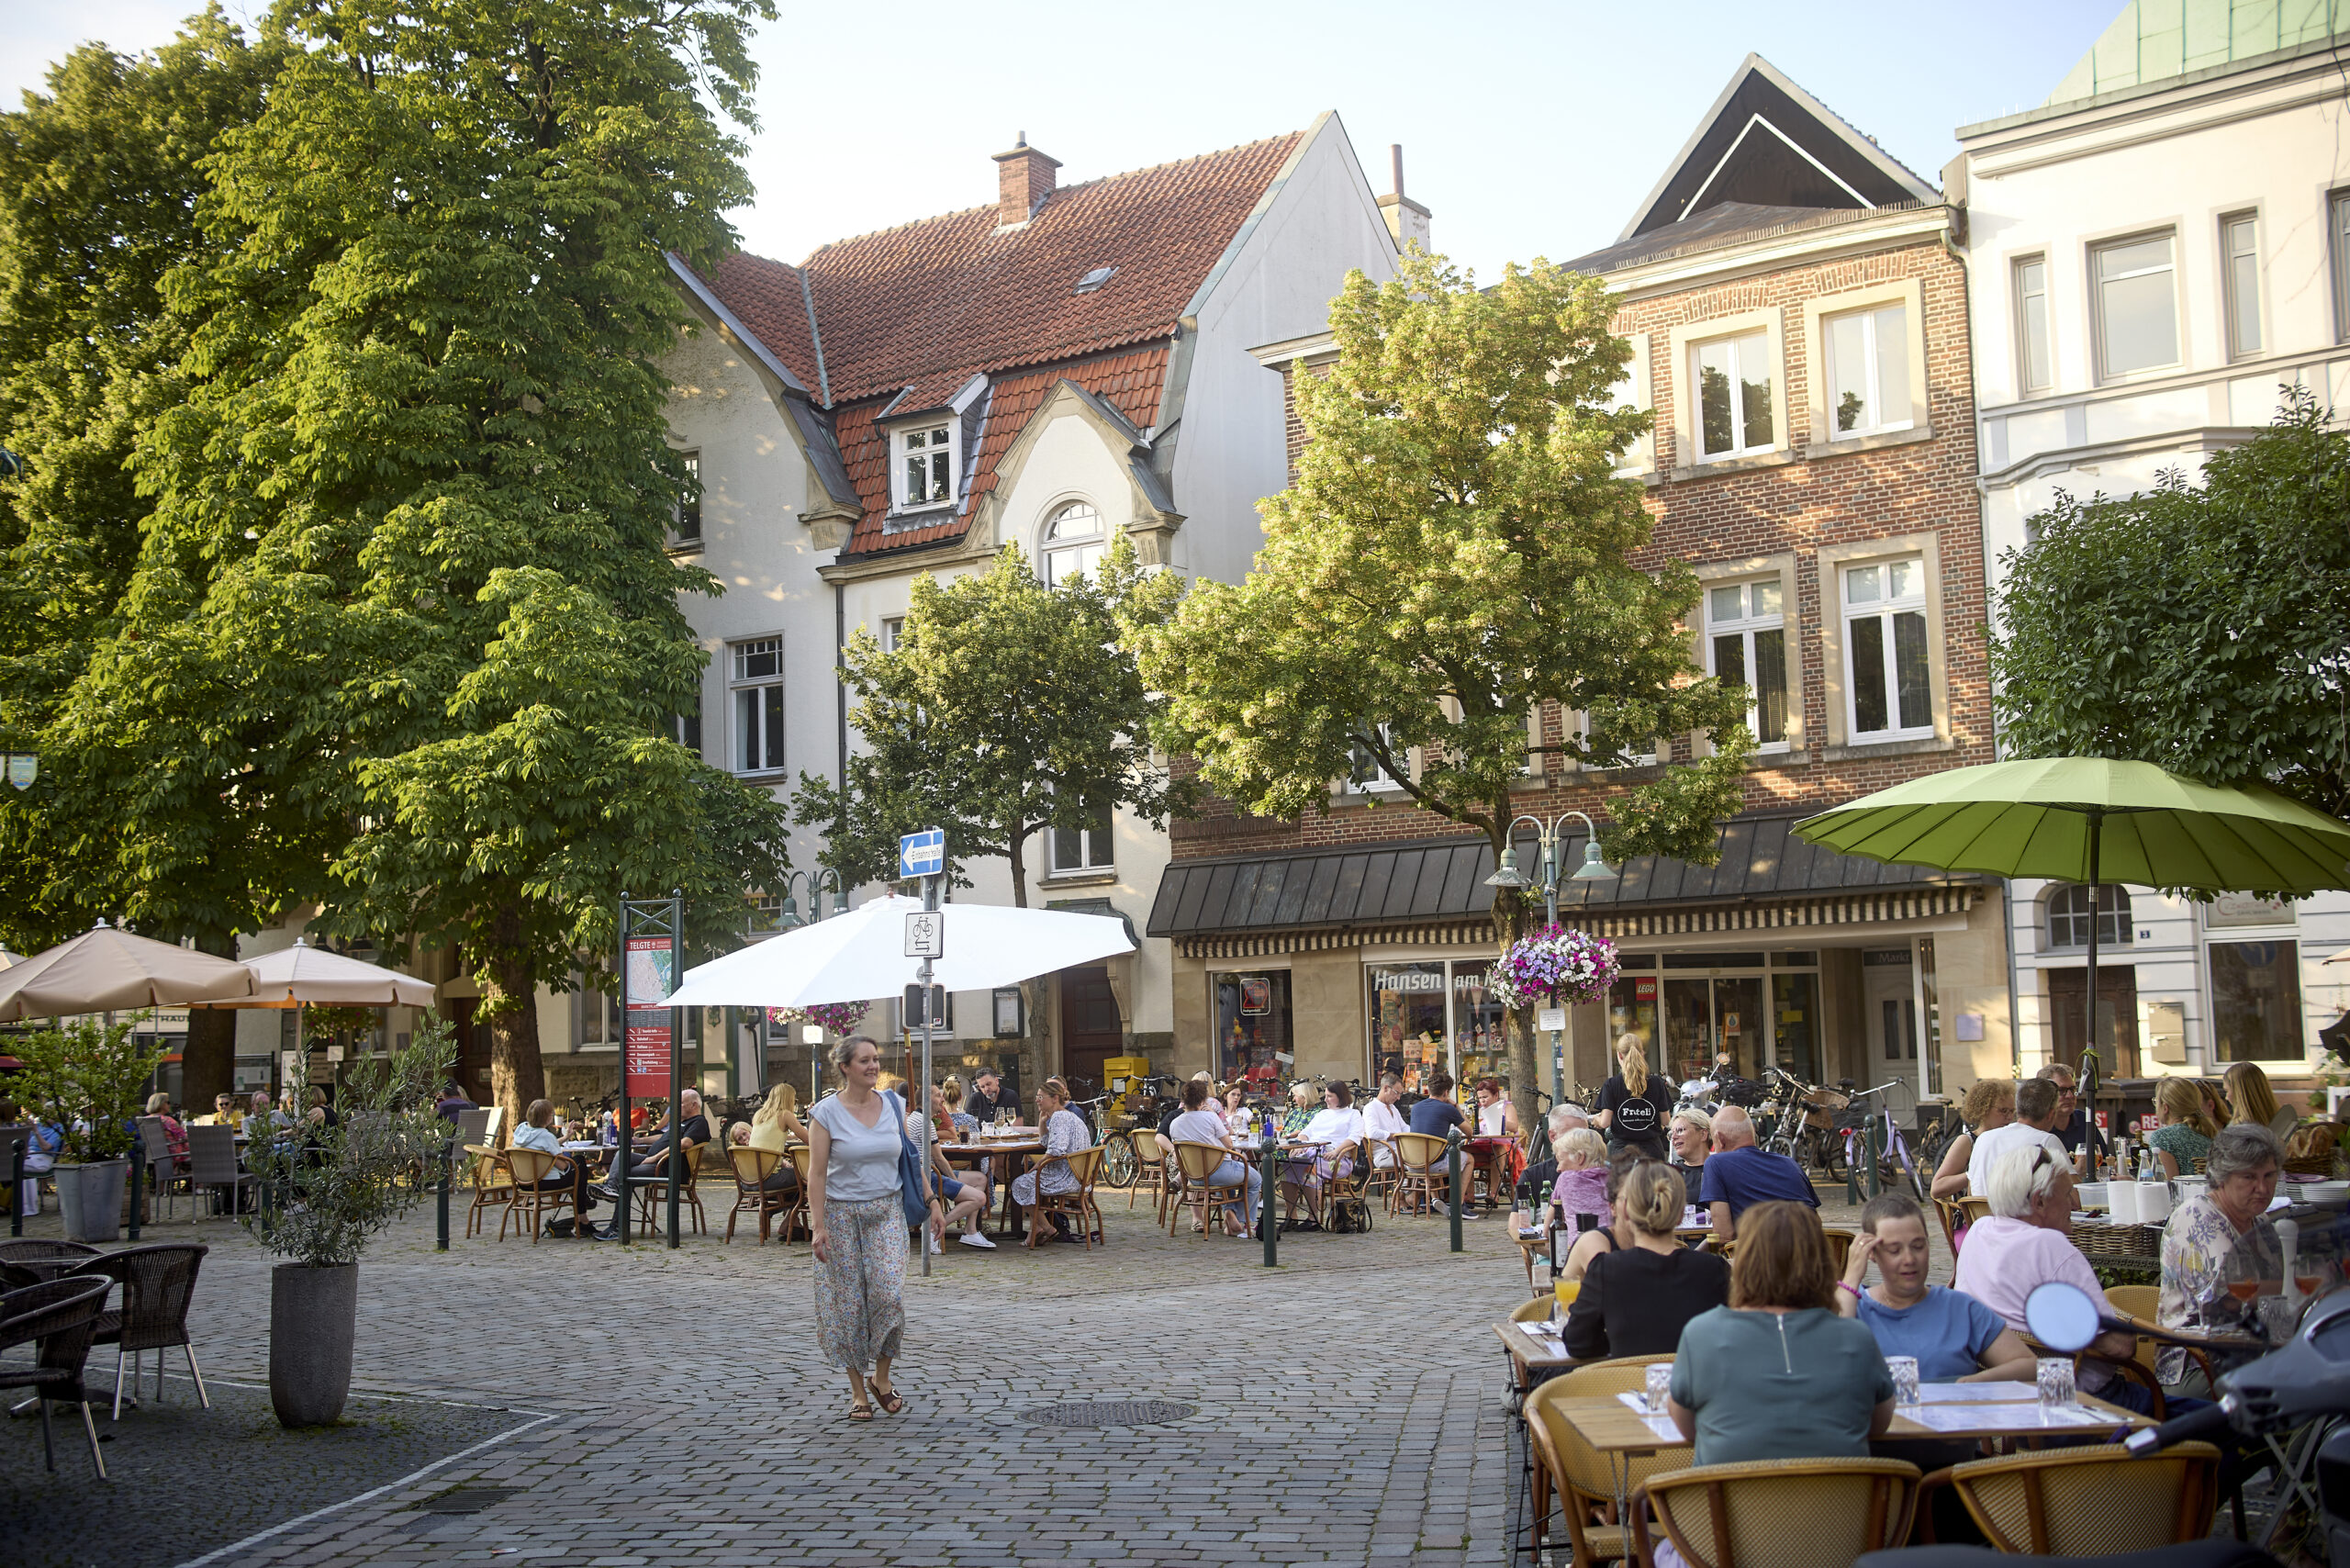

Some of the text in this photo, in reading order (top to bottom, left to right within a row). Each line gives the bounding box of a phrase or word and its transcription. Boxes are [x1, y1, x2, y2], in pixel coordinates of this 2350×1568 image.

[630, 941, 651, 950] TELGTE
[1878, 952, 1910, 963] Markt
[1374, 970, 1441, 991] Hansen
[1455, 974, 1479, 988] am
[1638, 983, 1655, 993] LEGO
